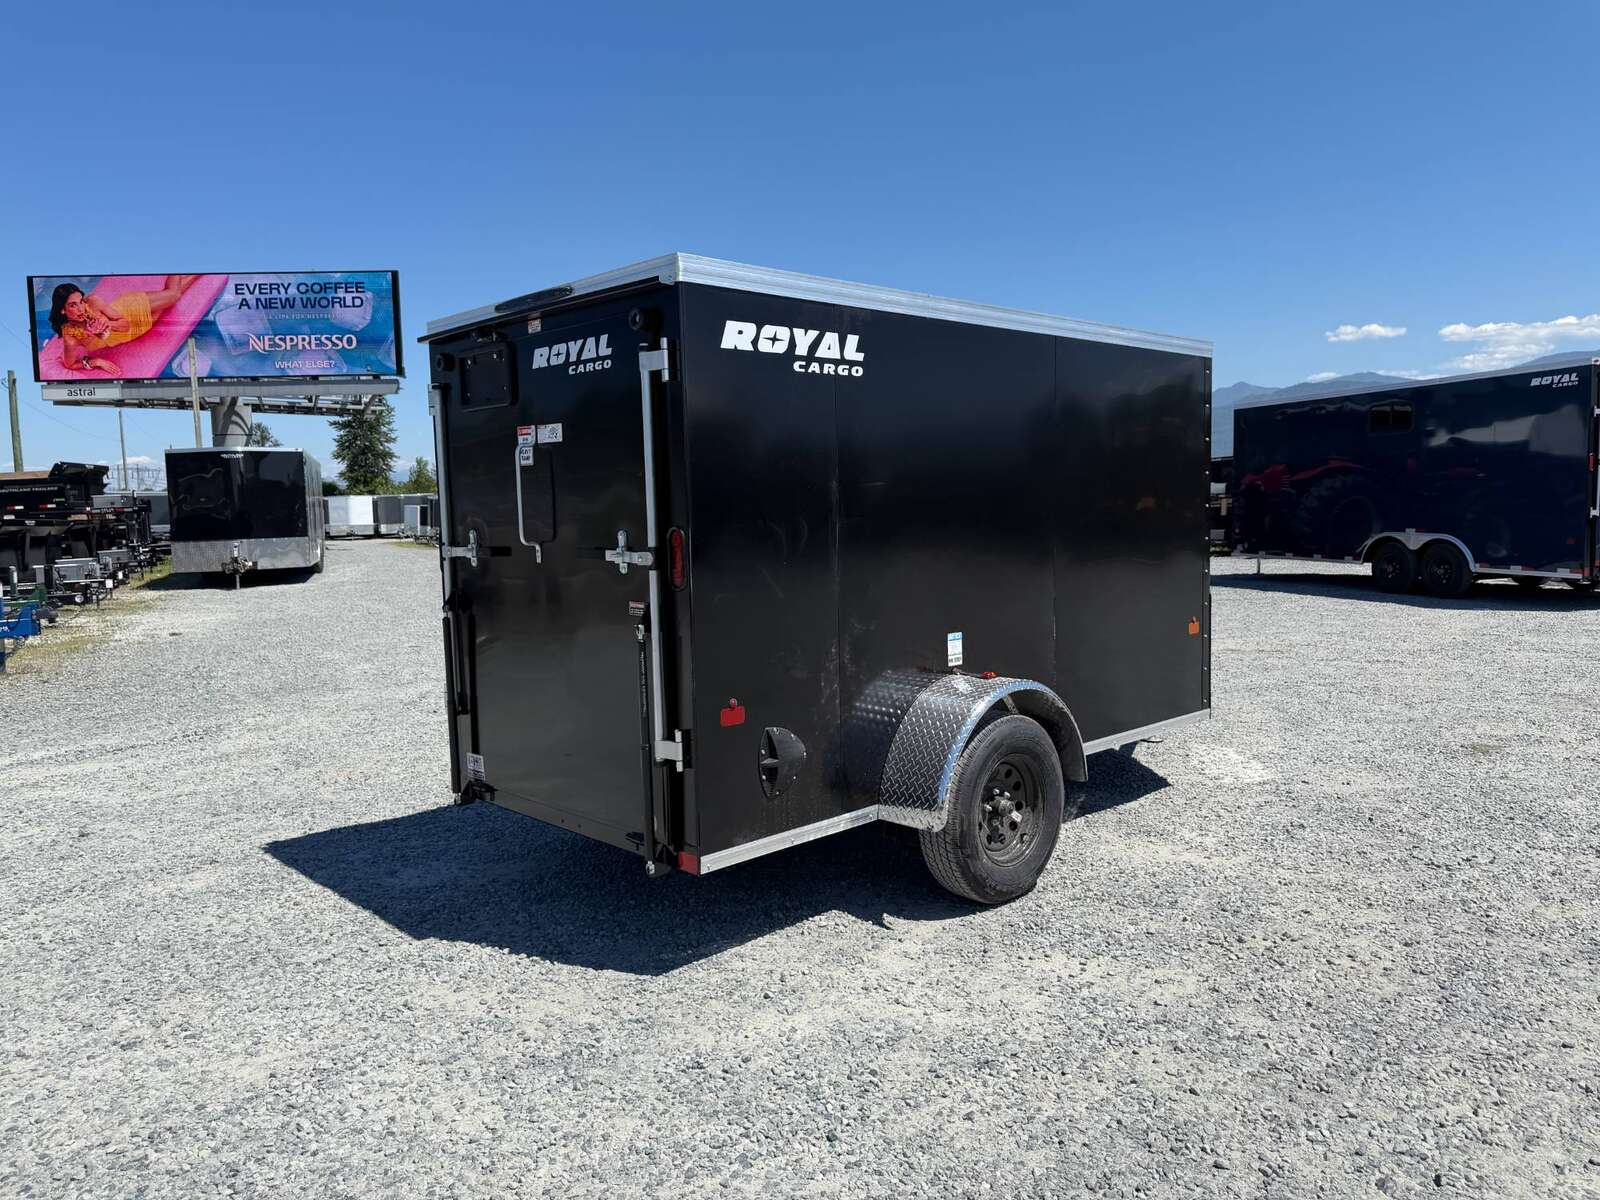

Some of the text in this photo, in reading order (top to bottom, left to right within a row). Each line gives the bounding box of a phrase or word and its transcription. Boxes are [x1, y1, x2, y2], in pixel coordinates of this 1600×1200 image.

[234, 281, 366, 296] EVERY COFFEE
[238, 296, 364, 310] A NEW WORLD
[246, 332, 357, 354] NESPRESSO
[720, 319, 865, 362] ROYAL
[532, 333, 613, 370] ROYAL
[274, 360, 336, 369] WHAT ELSE?
[568, 359, 612, 375] CARGO
[793, 360, 864, 377] CARGO
[1530, 372, 1579, 387] ROYAL
[67, 387, 96, 396] astral
